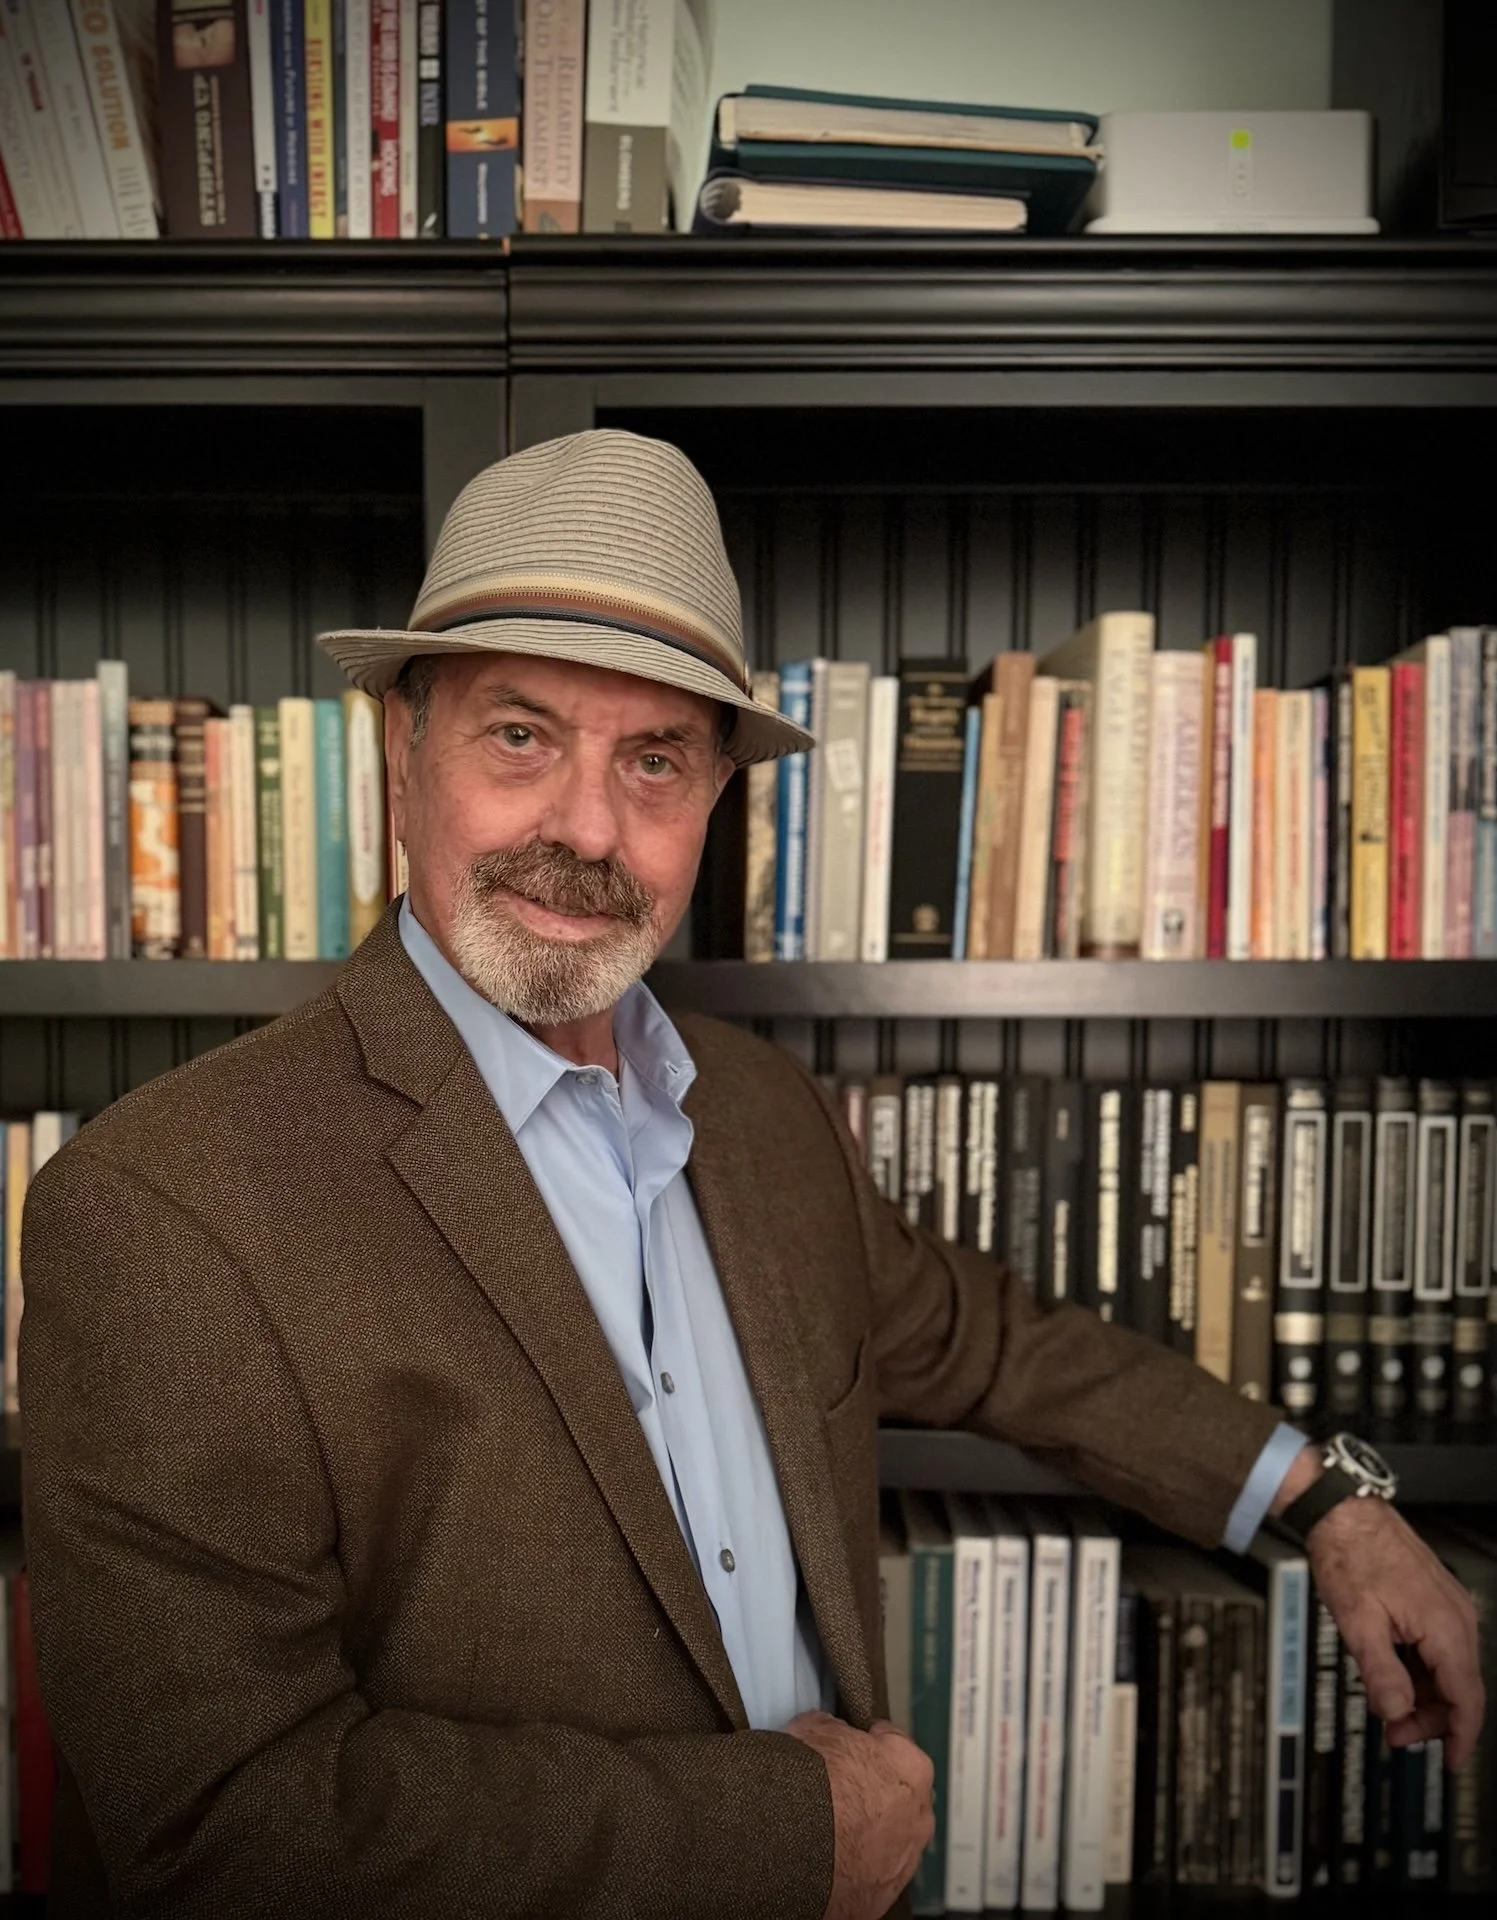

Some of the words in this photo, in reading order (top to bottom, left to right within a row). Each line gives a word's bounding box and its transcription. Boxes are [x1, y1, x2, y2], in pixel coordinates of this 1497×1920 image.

[535, 0, 554, 48] OLD
[305, 38, 325, 111] BURSTING
[476, 40, 488, 66] THE
[90, 44, 133, 152] SOLUTION
[476, 70, 488, 110] BIBLE
[306, 118, 325, 155] WITH
[532, 56, 554, 186] TESTAMENT
[556, 56, 577, 185] RELIABILITY
[309, 162, 326, 218] ENERGY
[380, 139, 398, 196] HOCKING
[616, 135, 634, 211] BLOMBERG
